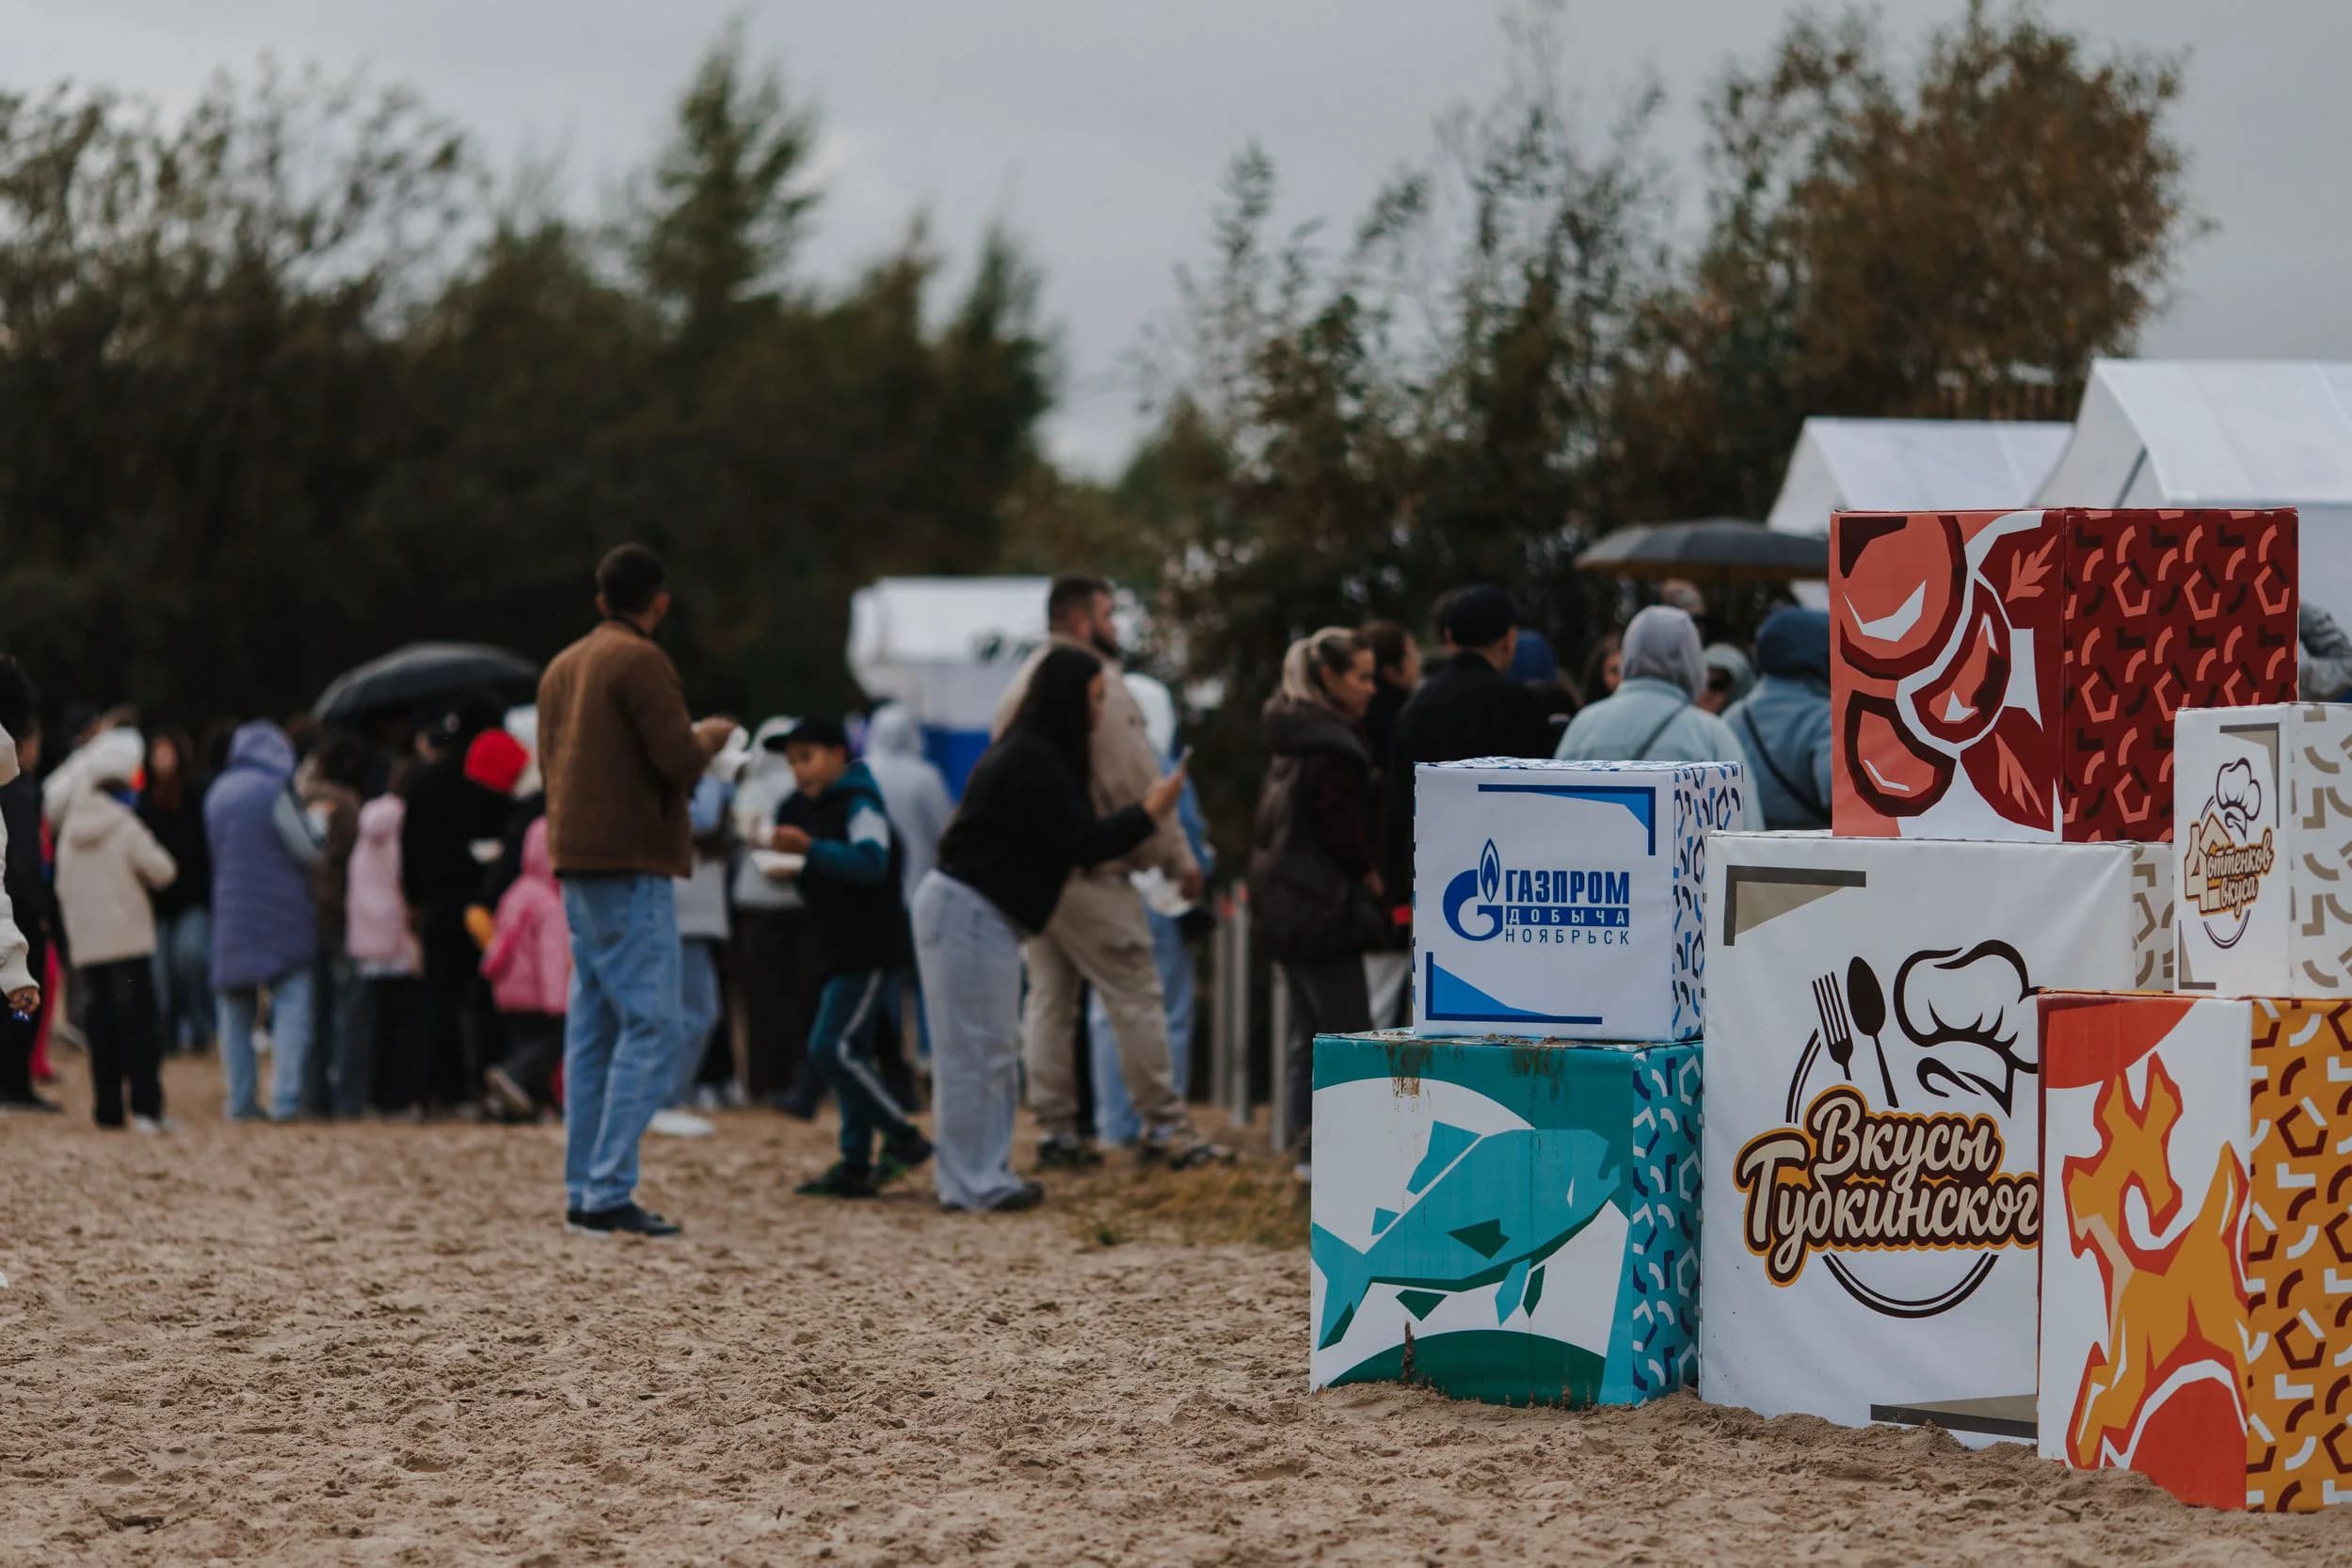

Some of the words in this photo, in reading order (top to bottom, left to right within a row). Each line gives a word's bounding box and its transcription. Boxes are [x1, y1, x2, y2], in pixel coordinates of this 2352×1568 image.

[2207, 828, 2273, 878] оттенков
[1506, 870, 1629, 904] ГАЗПРОМ
[2221, 876, 2256, 917] вкуса
[1509, 908, 1625, 925] ДОБЫЧА
[1506, 927, 1629, 945] НОЯБРЬСК
[1811, 1094, 1997, 1194] Вкусы
